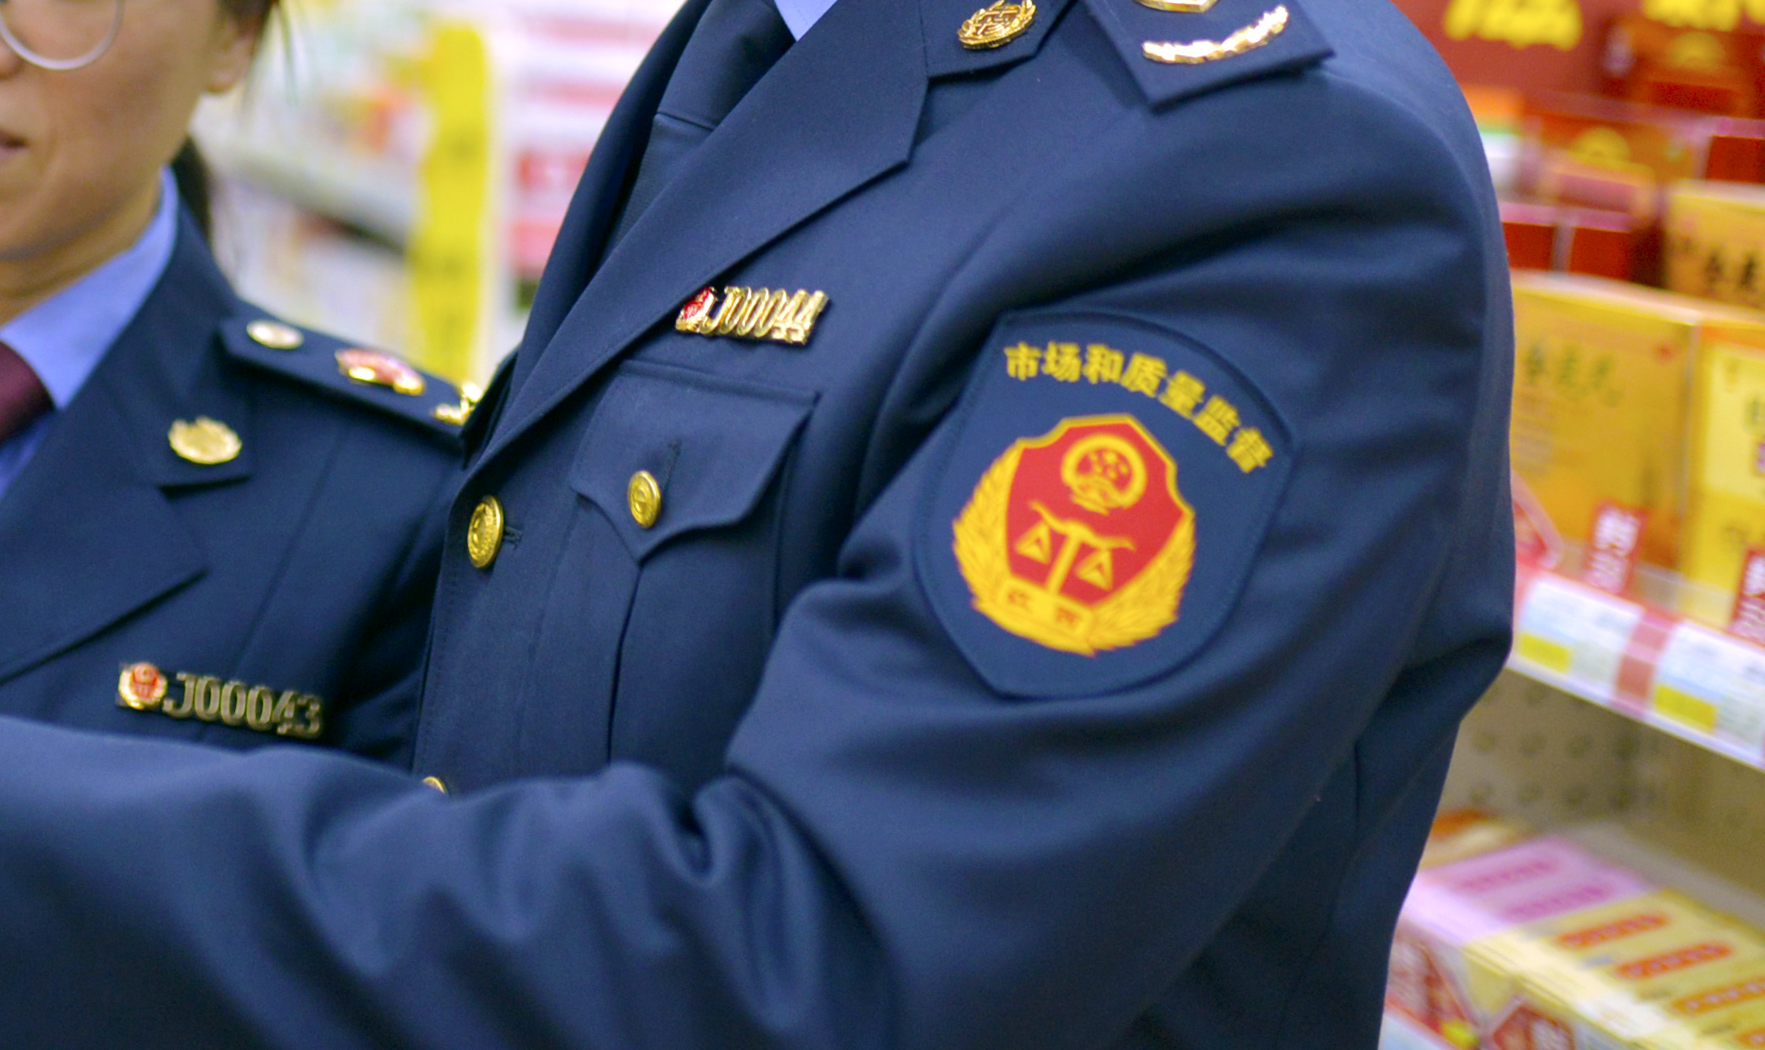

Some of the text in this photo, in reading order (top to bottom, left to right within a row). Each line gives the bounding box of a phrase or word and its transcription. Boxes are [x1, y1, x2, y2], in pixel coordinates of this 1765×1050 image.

[699, 286, 829, 344] J00044
[1004, 341, 1274, 473] 市场和质量监督
[162, 672, 321, 739] J00043
